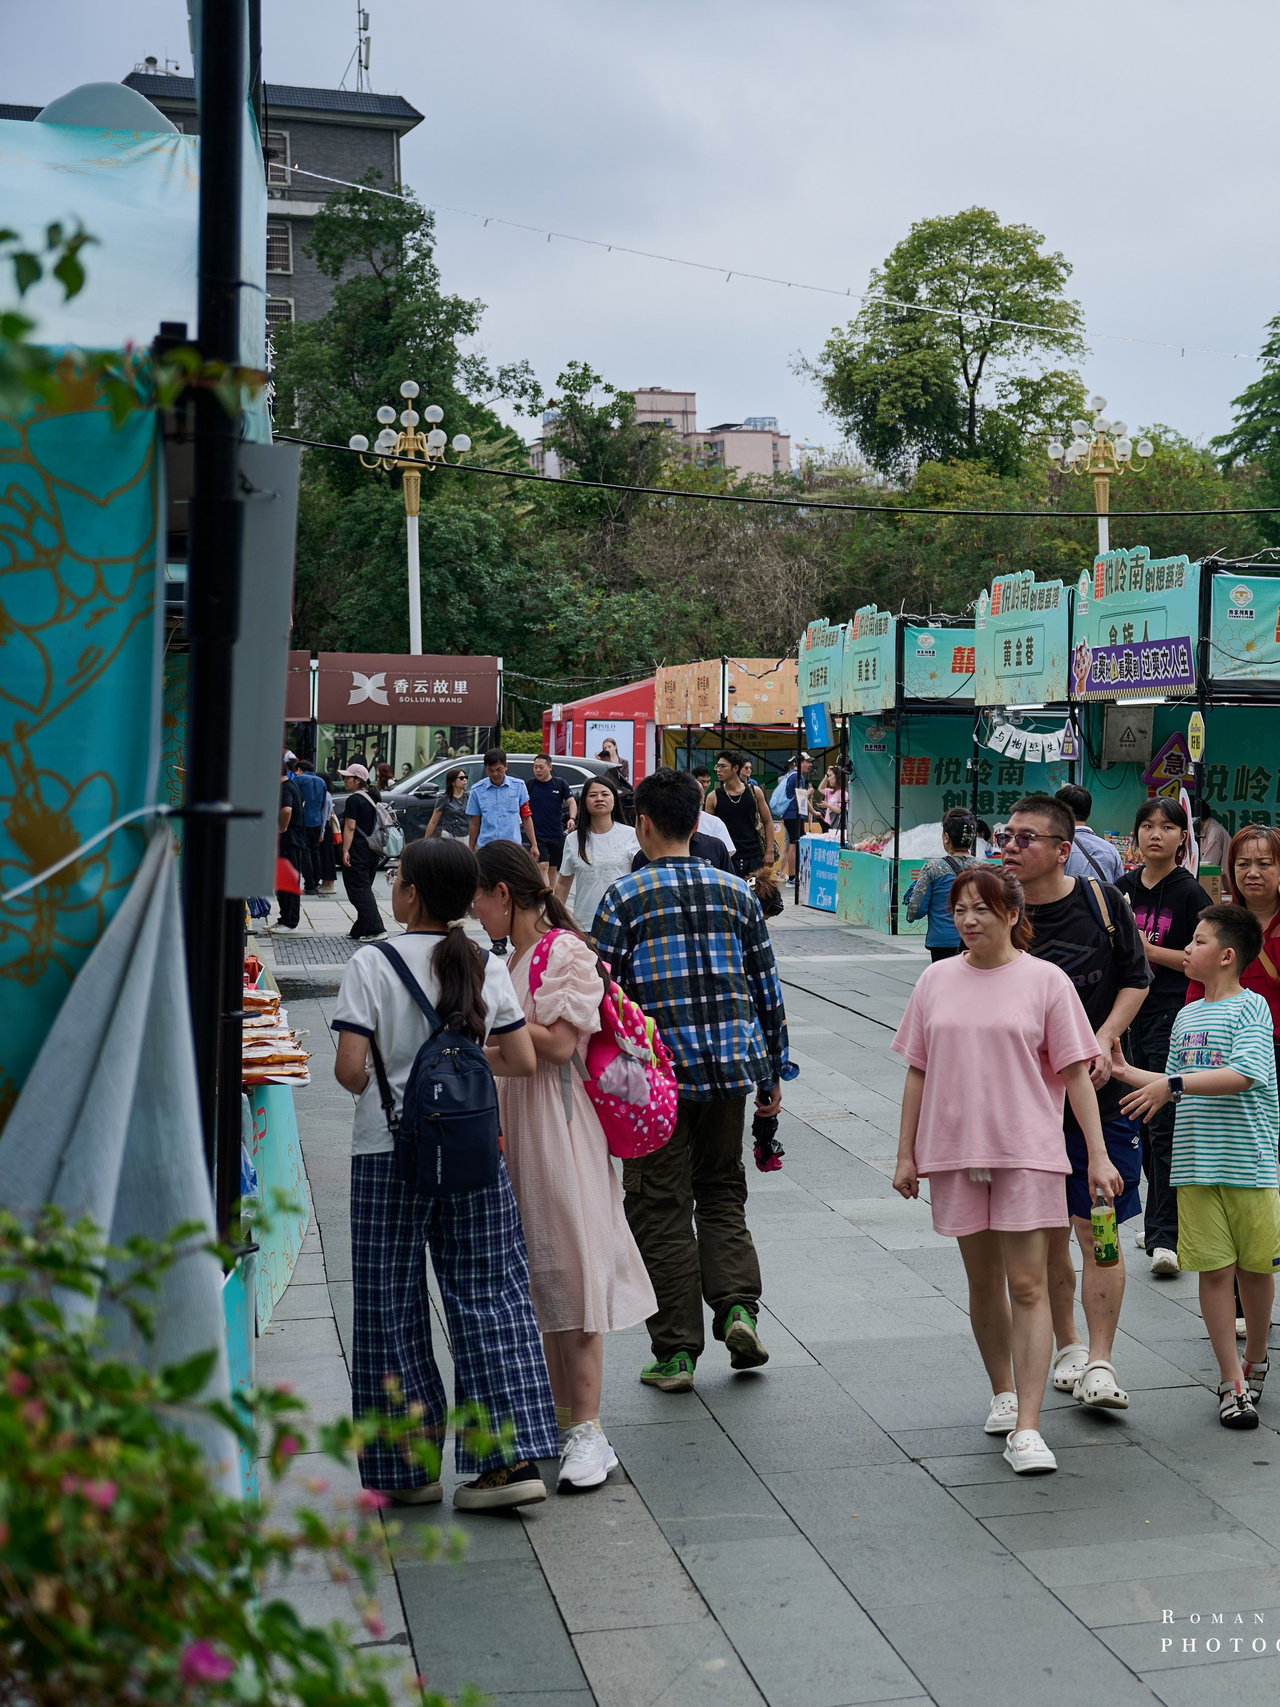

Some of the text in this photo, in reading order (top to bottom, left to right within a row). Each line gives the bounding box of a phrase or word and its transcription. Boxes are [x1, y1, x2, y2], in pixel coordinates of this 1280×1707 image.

[1003, 635, 1034, 668] 黄金巷
[393, 679, 469, 695] 香云故里
[1163, 752, 1185, 776] 急
